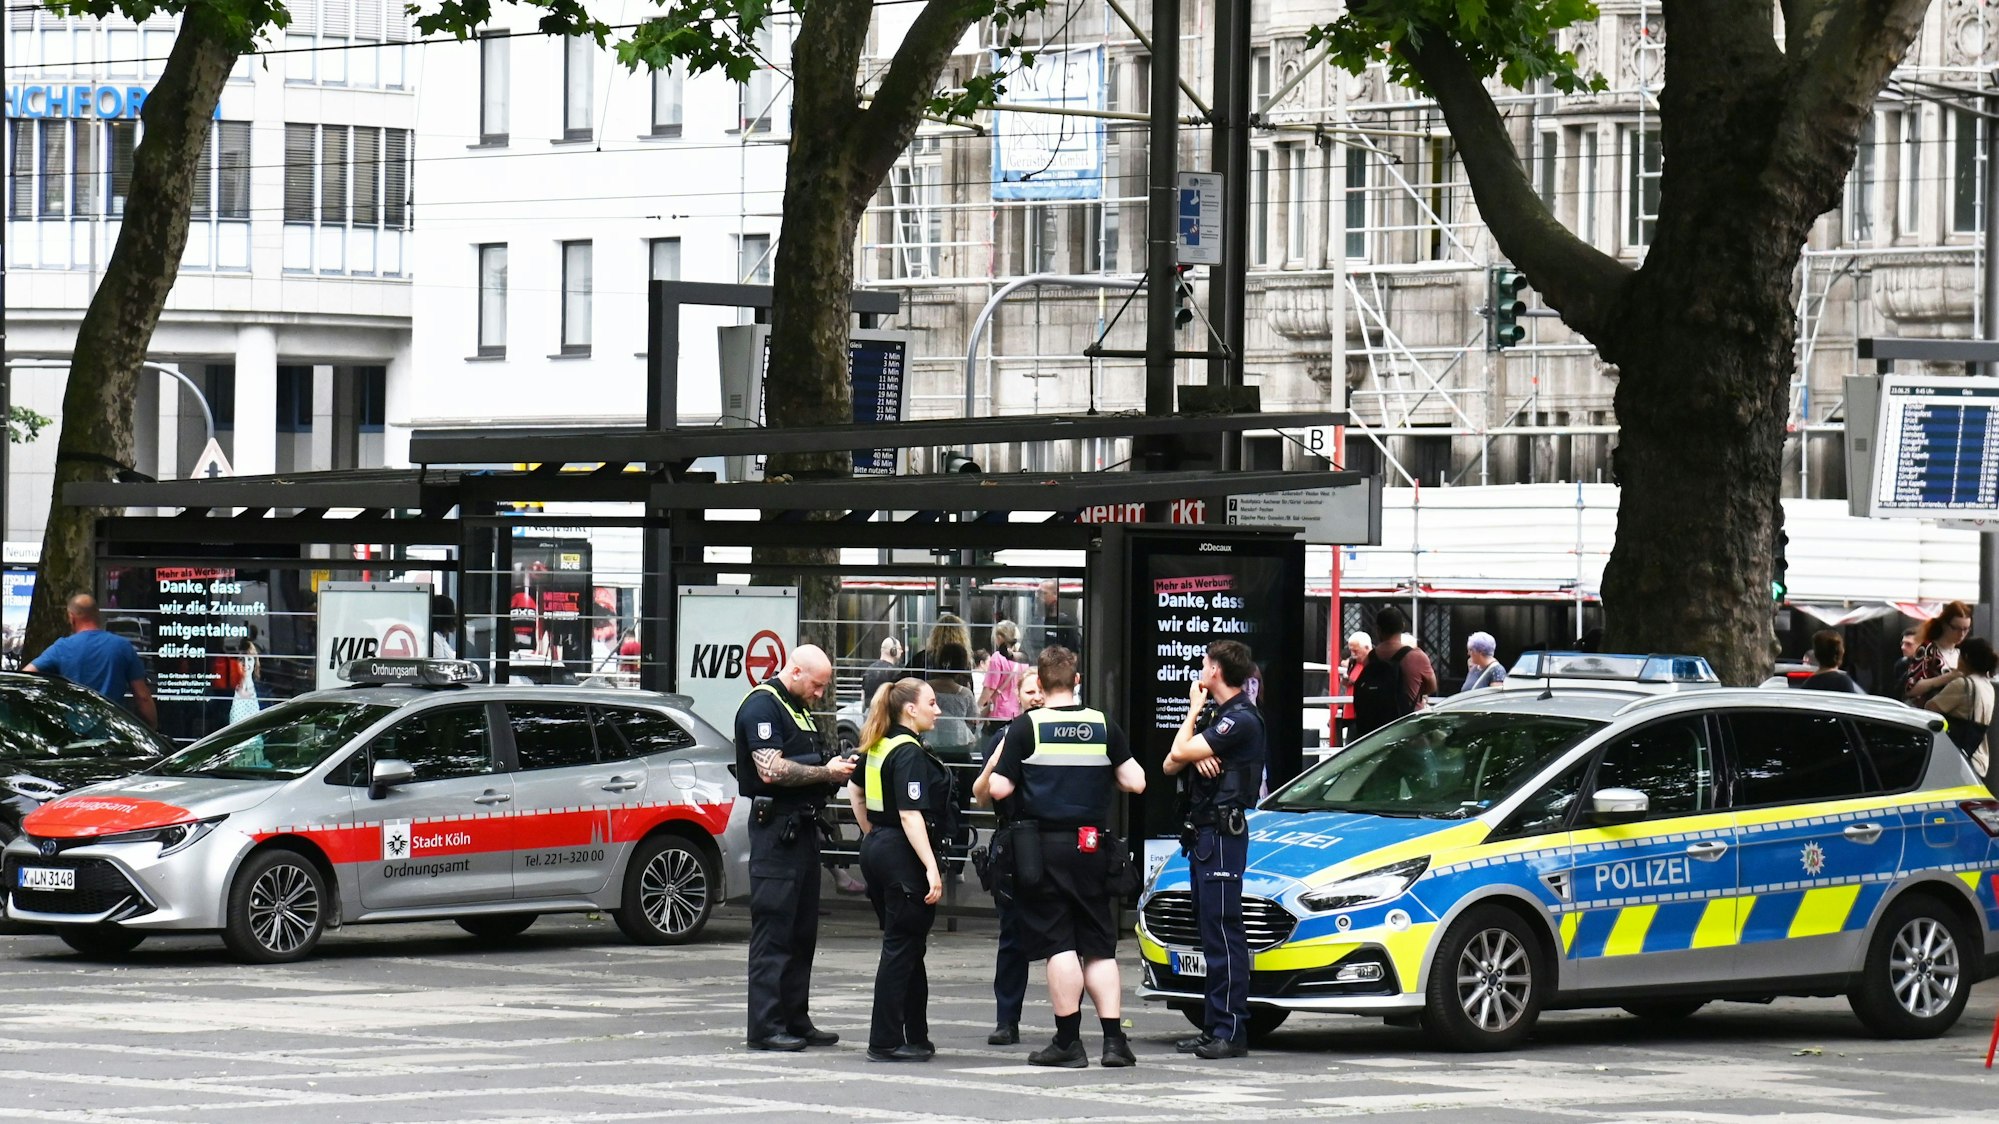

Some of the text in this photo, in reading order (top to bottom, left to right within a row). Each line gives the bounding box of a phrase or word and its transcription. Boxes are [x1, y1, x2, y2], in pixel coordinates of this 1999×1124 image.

[1311, 429, 1324, 450] B
[854, 466, 867, 474] Bitte
[1074, 499, 1206, 525] Neumrkt
[6, 546, 40, 558] Neuma
[1198, 543, 1232, 552] JCDecaux
[157, 570, 178, 579] Mehr
[181, 568, 192, 578] als
[160, 579, 242, 595] Danke, dass
[1156, 577, 1234, 591] Mehr als Werbung
[160, 600, 266, 616] wir die Zukunft
[1158, 592, 1245, 610] Danke, dass
[159, 621, 248, 640] mitgestalten
[1158, 615, 1258, 633] wir die Zukun
[158, 643, 206, 658] dürfen
[329, 637, 380, 670] KVB
[1157, 640, 1208, 661] mitges
[371, 662, 418, 678] Ordnungsamt
[690, 644, 744, 679] KVB
[1156, 713, 1180, 721] Hamburg
[1053, 726, 1077, 738] KVB
[53, 799, 139, 814] Ordnungsamt
[412, 833, 471, 849] Stadt Köln
[1249, 830, 1344, 849] OLIZEI
[525, 855, 542, 867] Tel.
[591, 849, 604, 861] 00
[383, 858, 470, 879] Ordnungsamt
[1595, 857, 1691, 892] POLIZEI
[23, 869, 73, 886] K LN 3148
[1177, 955, 1199, 973] NRW
